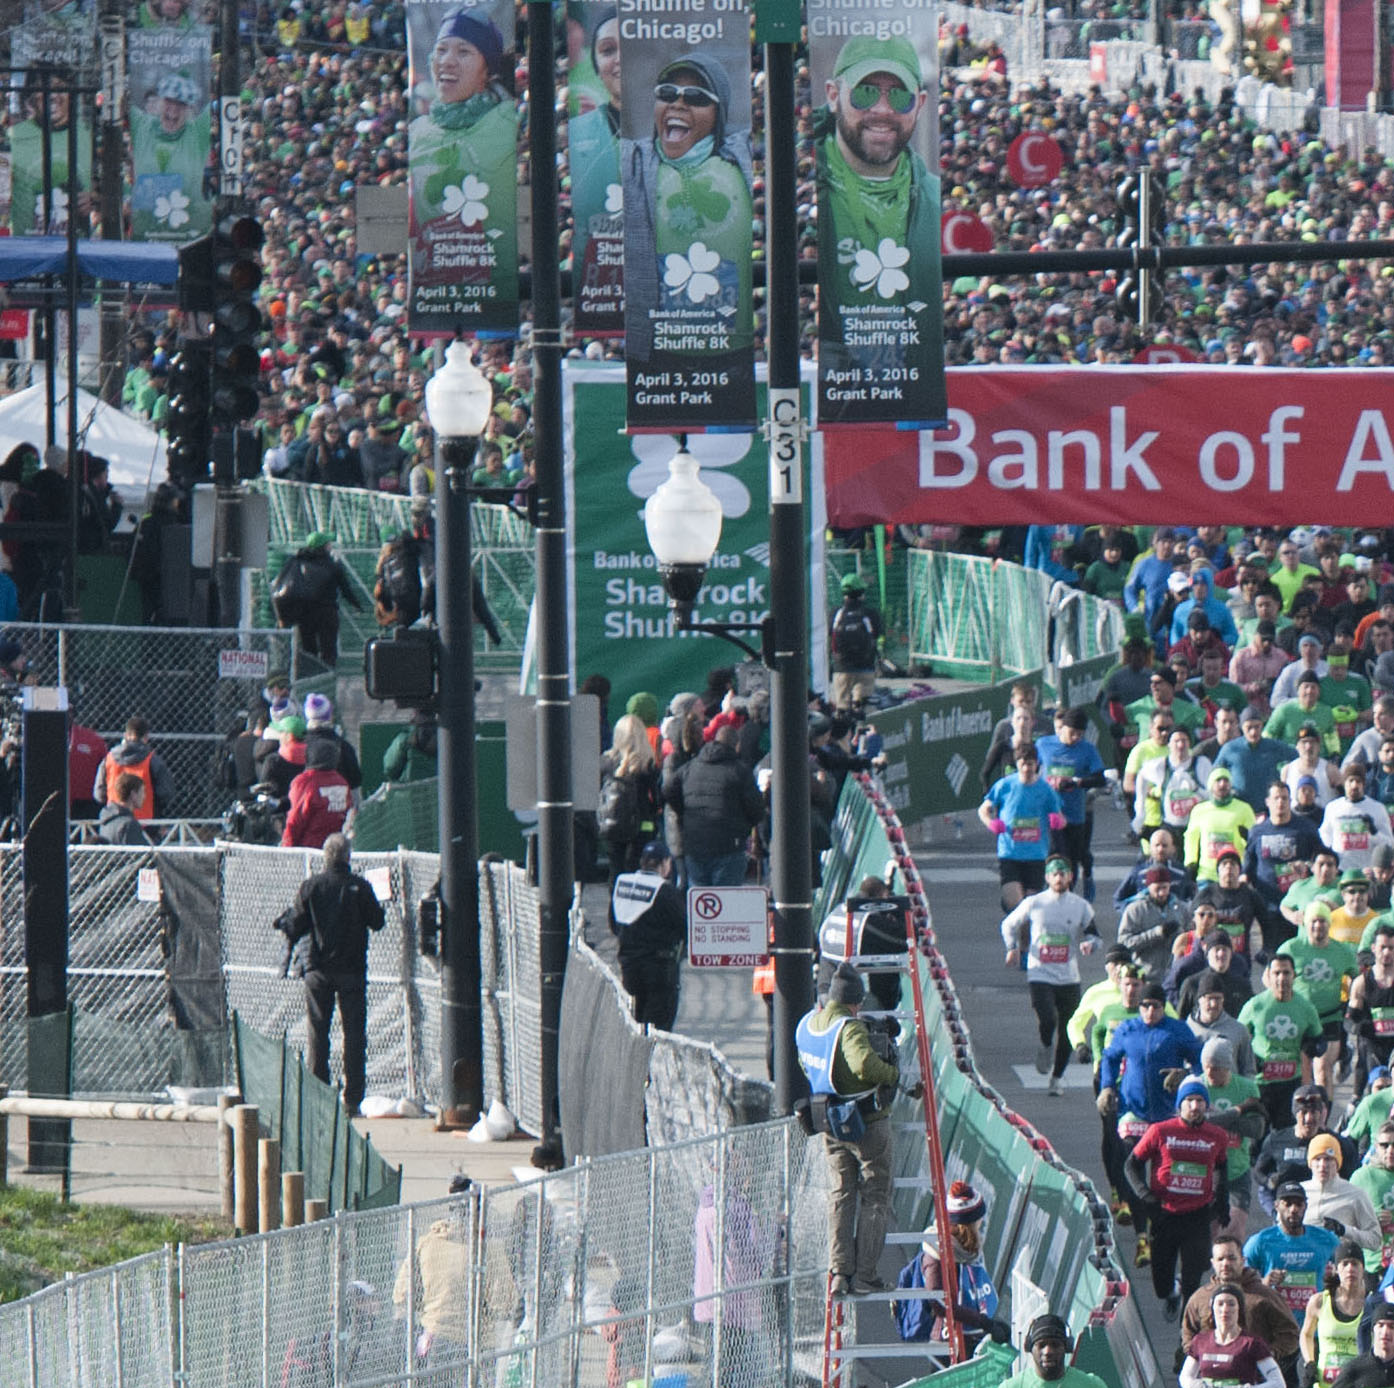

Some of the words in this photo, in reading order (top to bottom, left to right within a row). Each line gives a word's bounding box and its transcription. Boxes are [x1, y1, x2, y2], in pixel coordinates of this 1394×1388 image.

[620, 17, 724, 43] Chicago!
[810, 15, 913, 39] Chicago!
[1019, 136, 1046, 173] C
[943, 214, 974, 254] C
[433, 243, 495, 255] Shamrock
[433, 255, 475, 267] Shuffle
[479, 255, 497, 267] 8K
[416, 286, 447, 299] April
[450, 286, 460, 299] 3,
[464, 286, 496, 298] 2016
[581, 285, 612, 299] April
[416, 302, 451, 314] Grant
[454, 302, 482, 314] Park
[581, 301, 615, 314] Grant
[649, 309, 671, 320] Bank
[682, 309, 716, 320] America
[839, 305, 861, 315] Bank
[871, 305, 906, 315] America
[654, 322, 728, 336] Shamrock
[844, 317, 918, 332] Shamrock
[653, 336, 705, 350] Shuffle
[709, 336, 730, 350] 8K
[844, 331, 896, 346] Shuffle
[899, 331, 920, 346] 8K
[635, 373, 670, 389] April
[674, 373, 687, 389] 3,
[692, 373, 729, 388] 2016
[826, 367, 861, 384] April
[865, 367, 879, 384] 3,
[884, 367, 919, 383] 2016
[635, 391, 677, 406] Grant
[681, 391, 713, 406] Park
[826, 387, 868, 402] Grant
[872, 387, 903, 402] Park
[918, 405, 1161, 490] Bank
[1199, 405, 1304, 491] of
[593, 550, 641, 569] Bank
[221, 650, 266, 666] NATIONAL
[695, 926, 707, 934] NO
[711, 926, 750, 934] STOPPING
[711, 935, 751, 943] STANDING
[695, 954, 724, 965] TOW
[729, 954, 763, 965] ZONE
